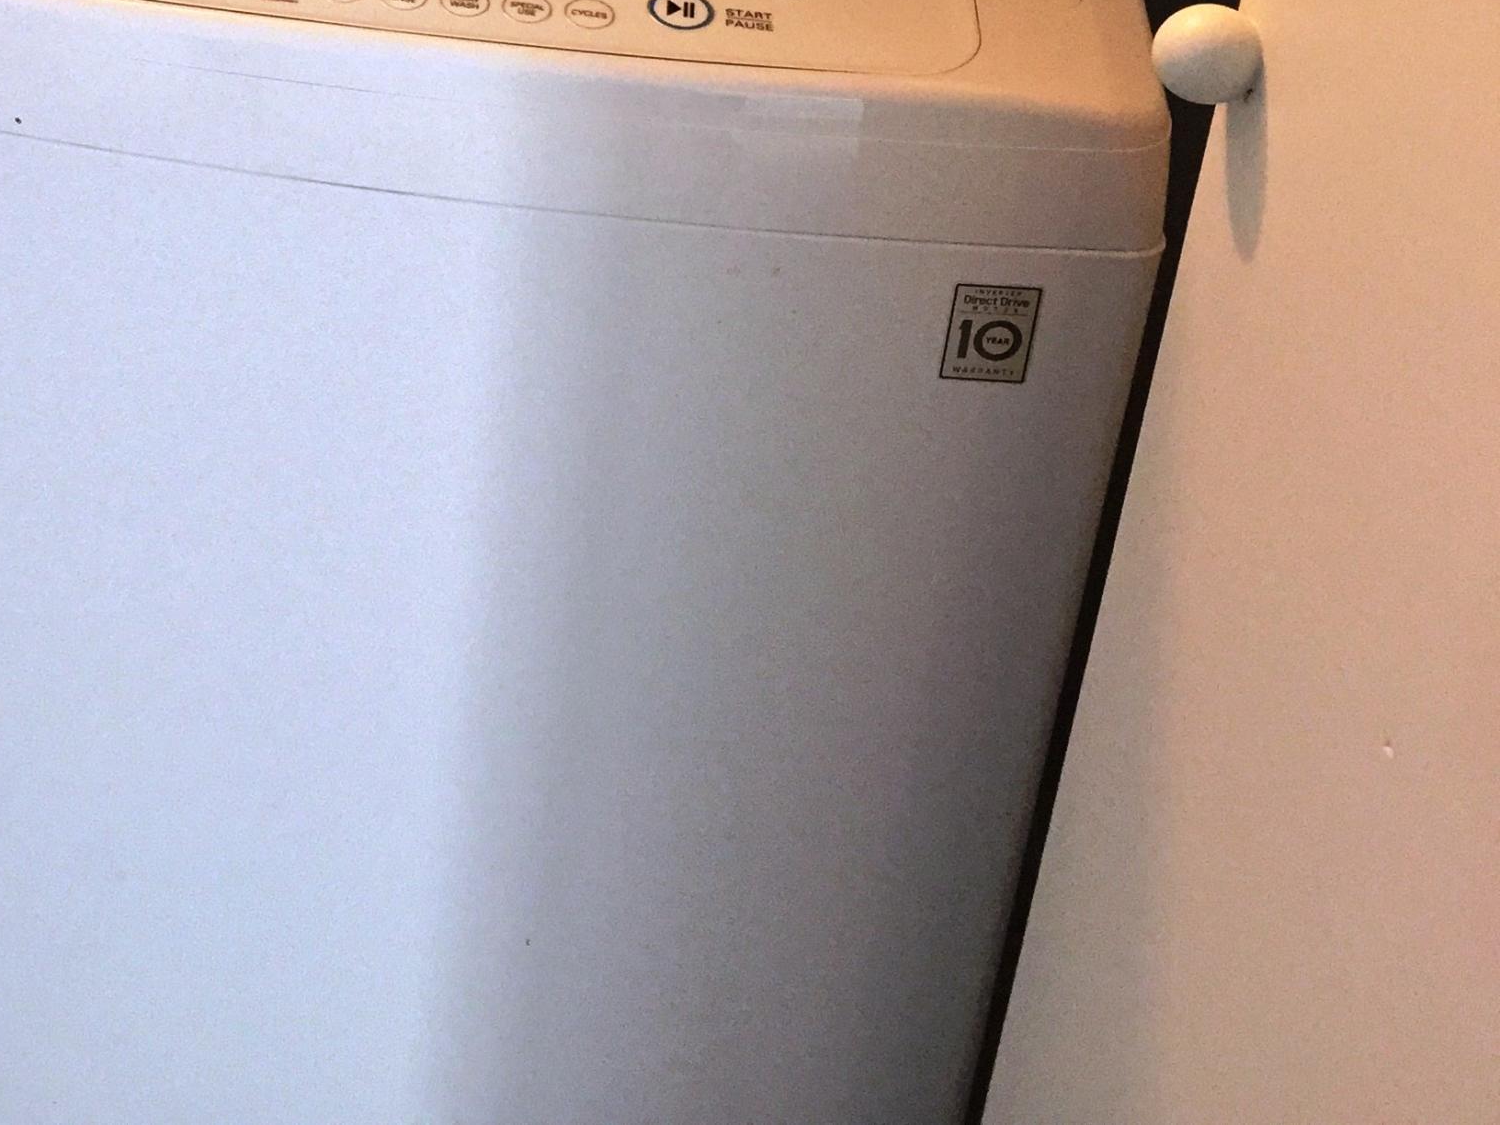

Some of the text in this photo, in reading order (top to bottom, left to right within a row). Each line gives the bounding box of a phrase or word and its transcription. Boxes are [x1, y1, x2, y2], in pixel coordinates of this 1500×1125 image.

[450, 1, 480, 10] WASH
[510, 0, 544, 11] SPECIAL
[517, 7, 537, 17] USE
[570, 8, 608, 20] CYCLES
[725, 8, 772, 19] START
[725, 19, 774, 32] PAUSE
[963, 294, 1031, 308] Direct Drive
[956, 319, 1023, 362] 10
[985, 336, 1010, 345] YEAR
[952, 365, 1014, 376] WARRANTY
